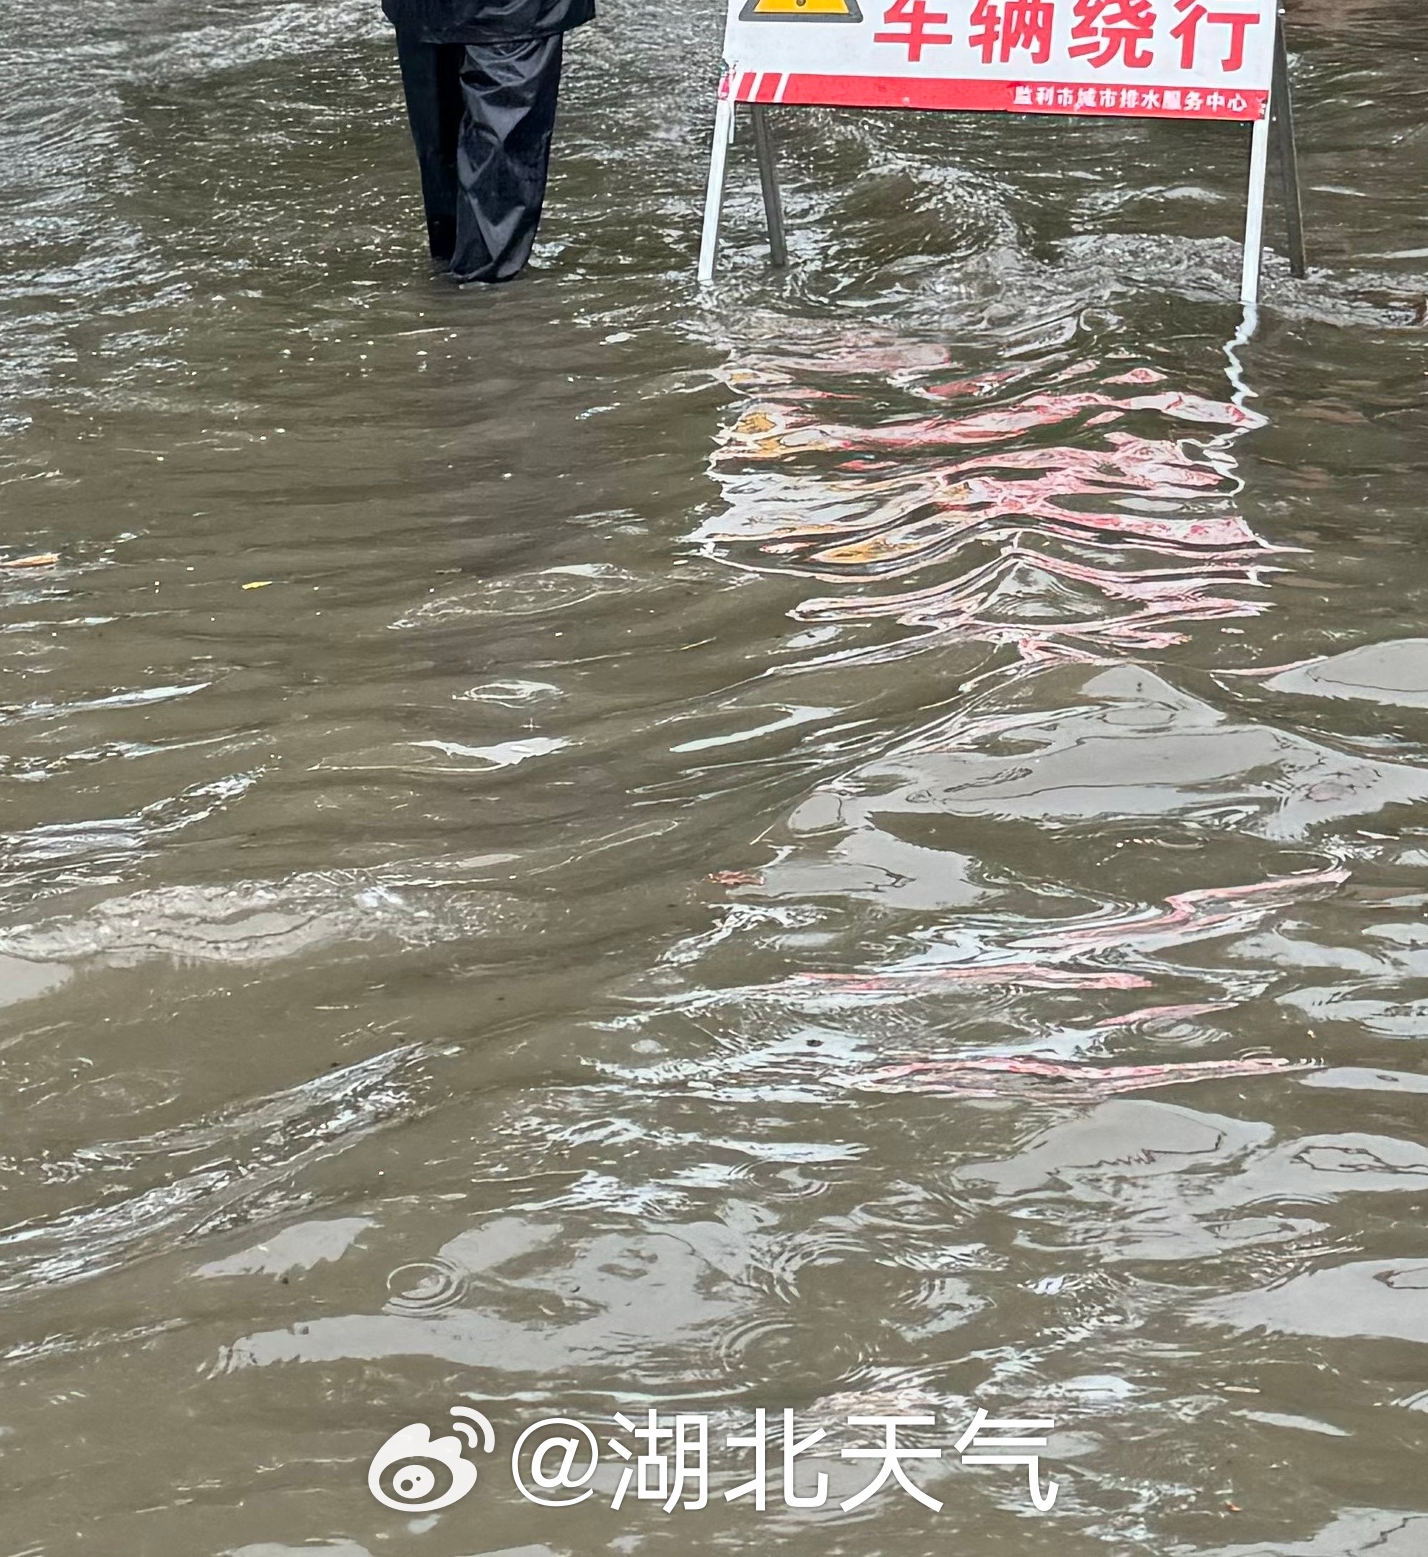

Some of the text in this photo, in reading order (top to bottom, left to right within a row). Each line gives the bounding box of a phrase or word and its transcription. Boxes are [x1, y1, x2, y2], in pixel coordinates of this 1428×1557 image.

[1013, 84, 1249, 113] 监利市城市排水服务中心
